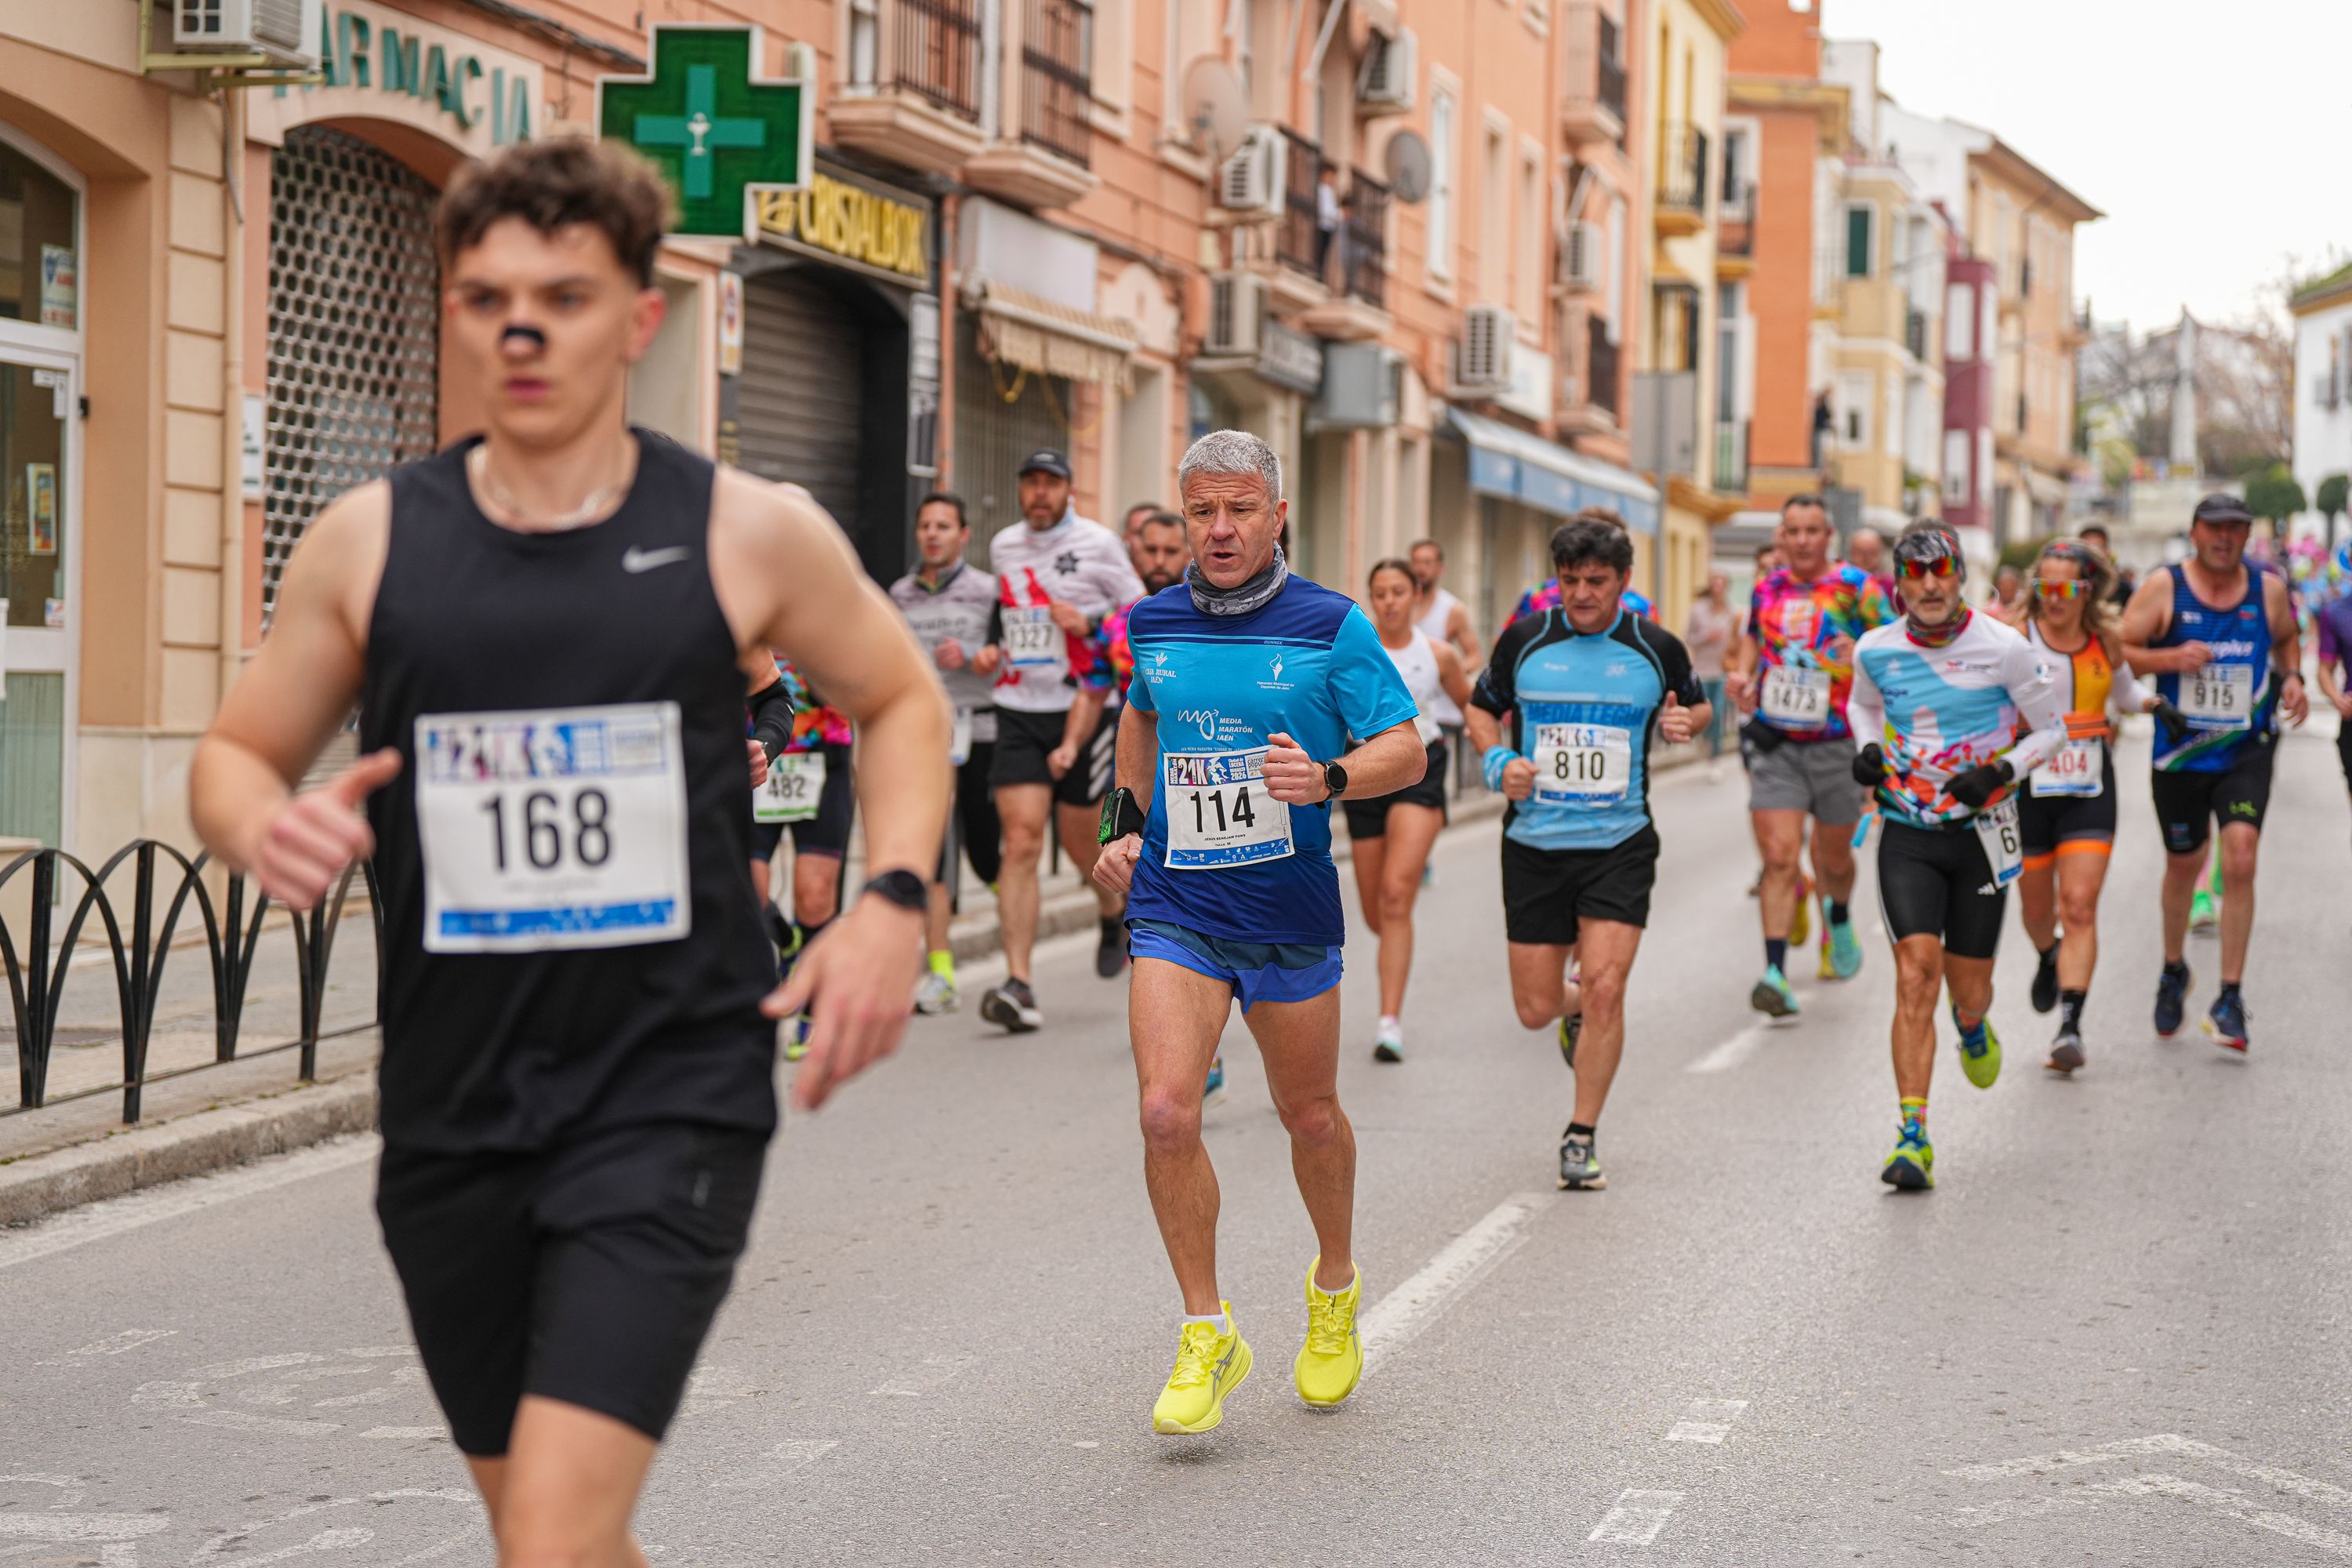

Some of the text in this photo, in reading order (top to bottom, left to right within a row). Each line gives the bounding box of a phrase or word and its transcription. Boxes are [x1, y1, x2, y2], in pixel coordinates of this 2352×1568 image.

[274, 2, 532, 144] ARMACIA
[1150, 675, 1163, 684] JAÉN
[1156, 669, 1177, 678] RURAL
[2194, 681, 2234, 710] 915
[1178, 758, 1208, 785] 21K
[1230, 771, 1247, 781] 2026
[1555, 751, 1605, 781] 810
[2046, 750, 2087, 775] 404
[767, 774, 806, 798] 482
[1190, 786, 1255, 833] 114
[480, 788, 612, 873] 168
[2001, 826, 2020, 854] 6
